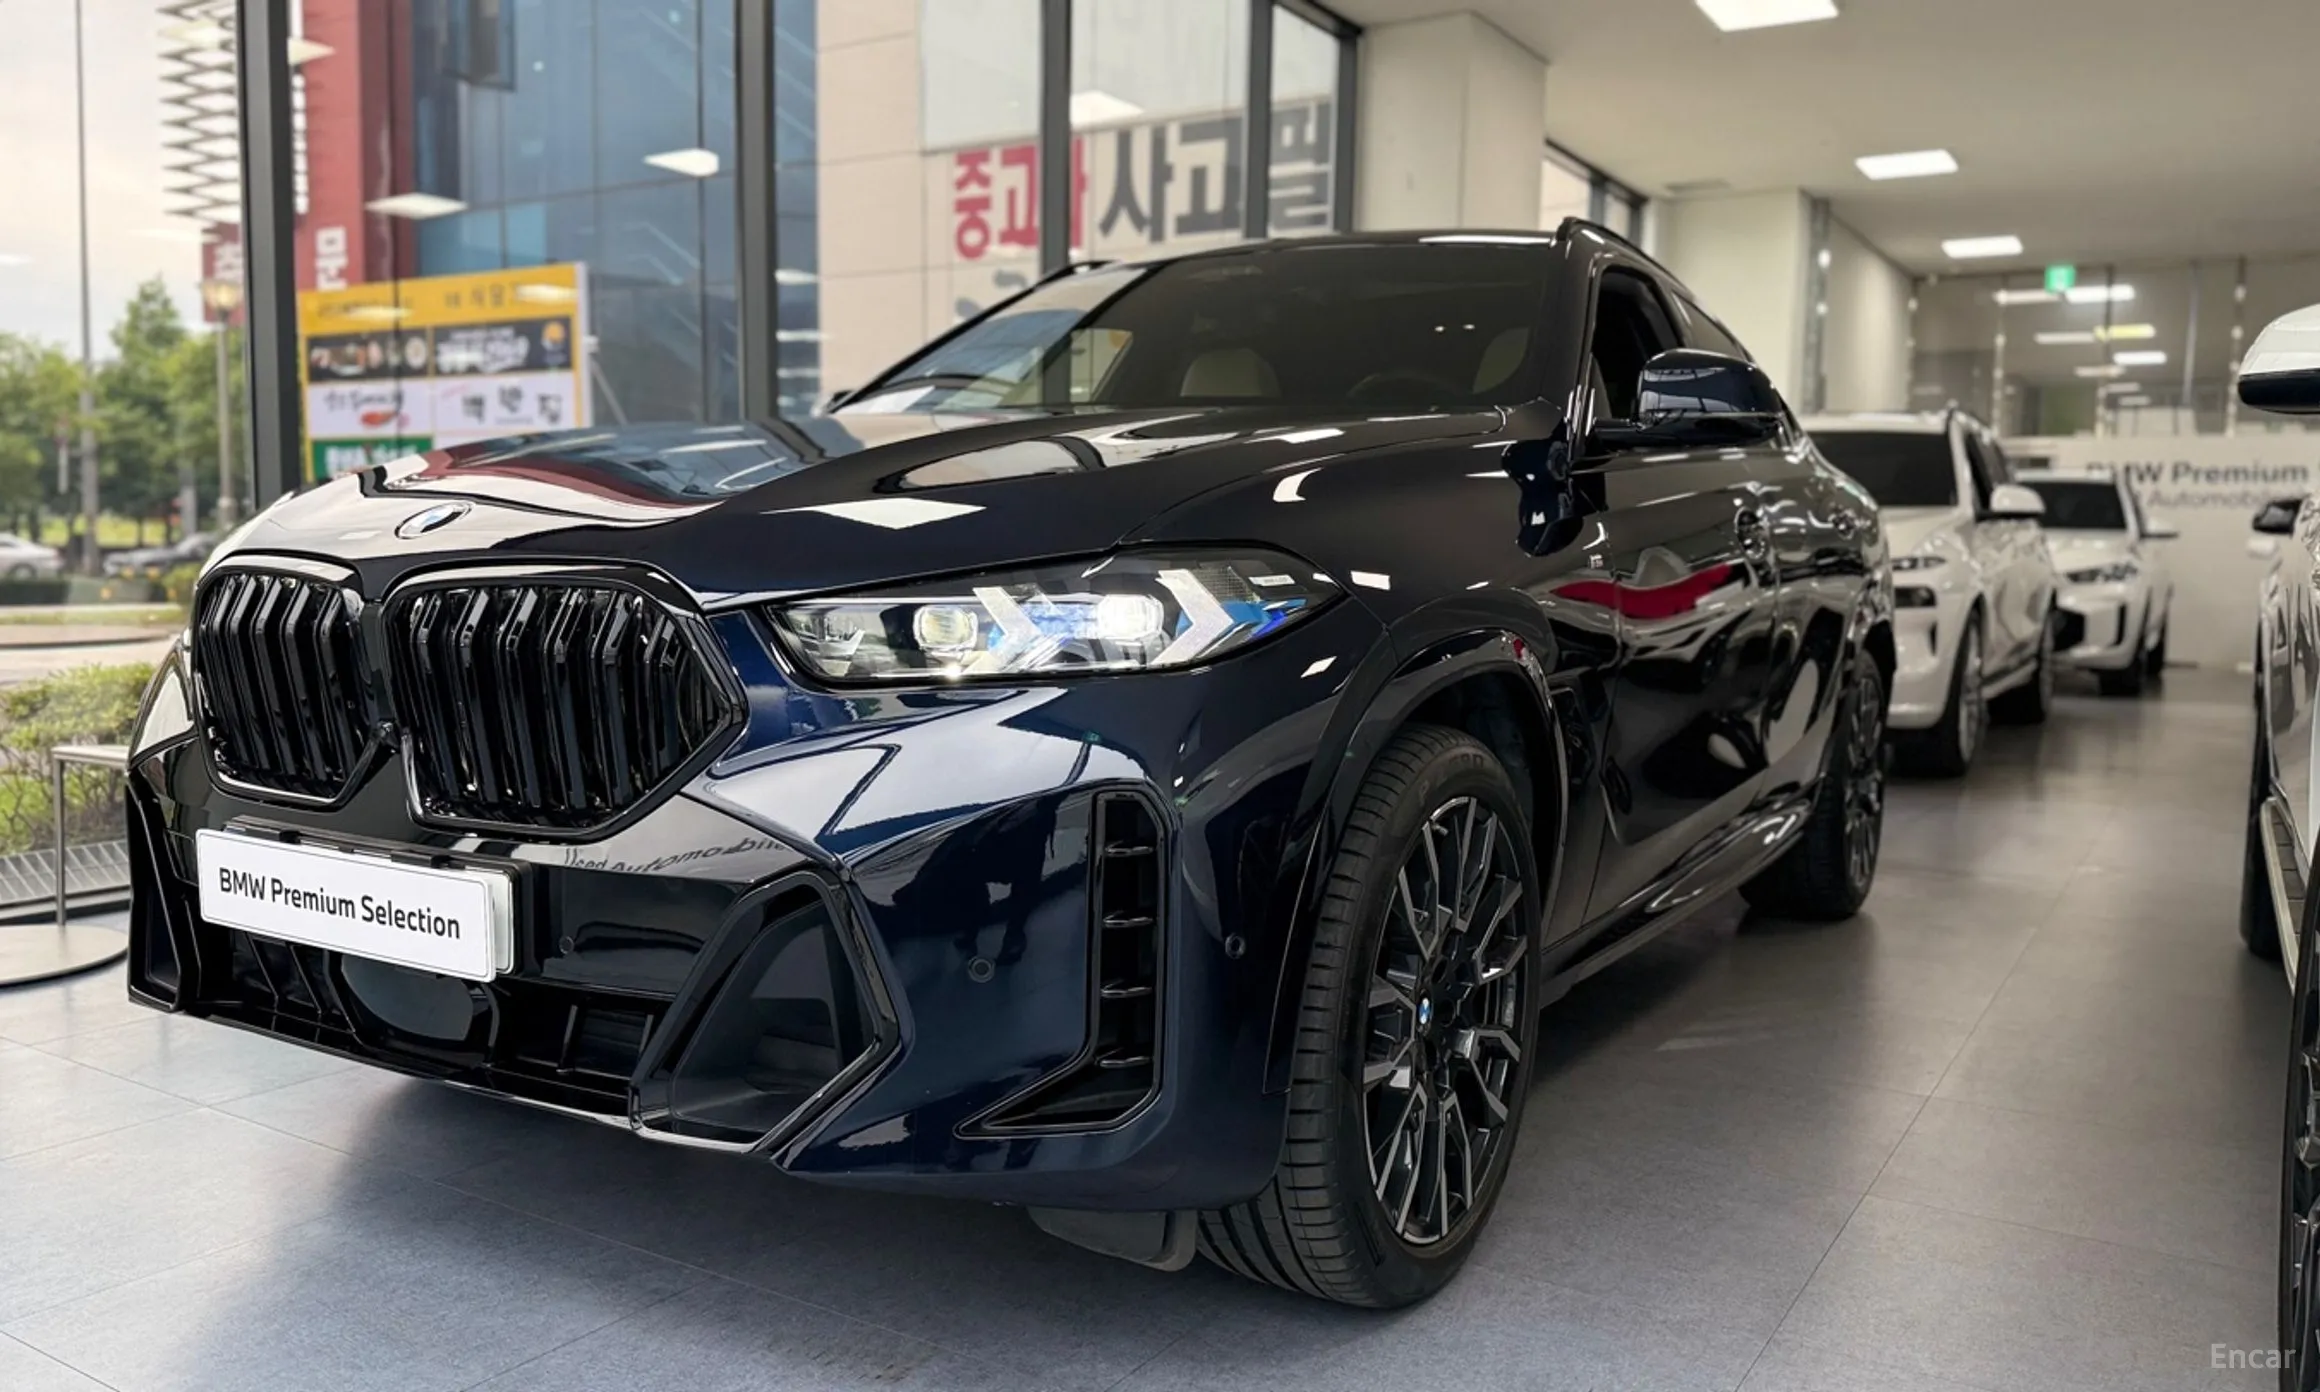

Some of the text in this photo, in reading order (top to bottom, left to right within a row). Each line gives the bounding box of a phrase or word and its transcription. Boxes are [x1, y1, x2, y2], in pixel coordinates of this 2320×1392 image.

[2171, 458, 2309, 483] Premium
[219, 866, 461, 940] BMW Premium Selection
